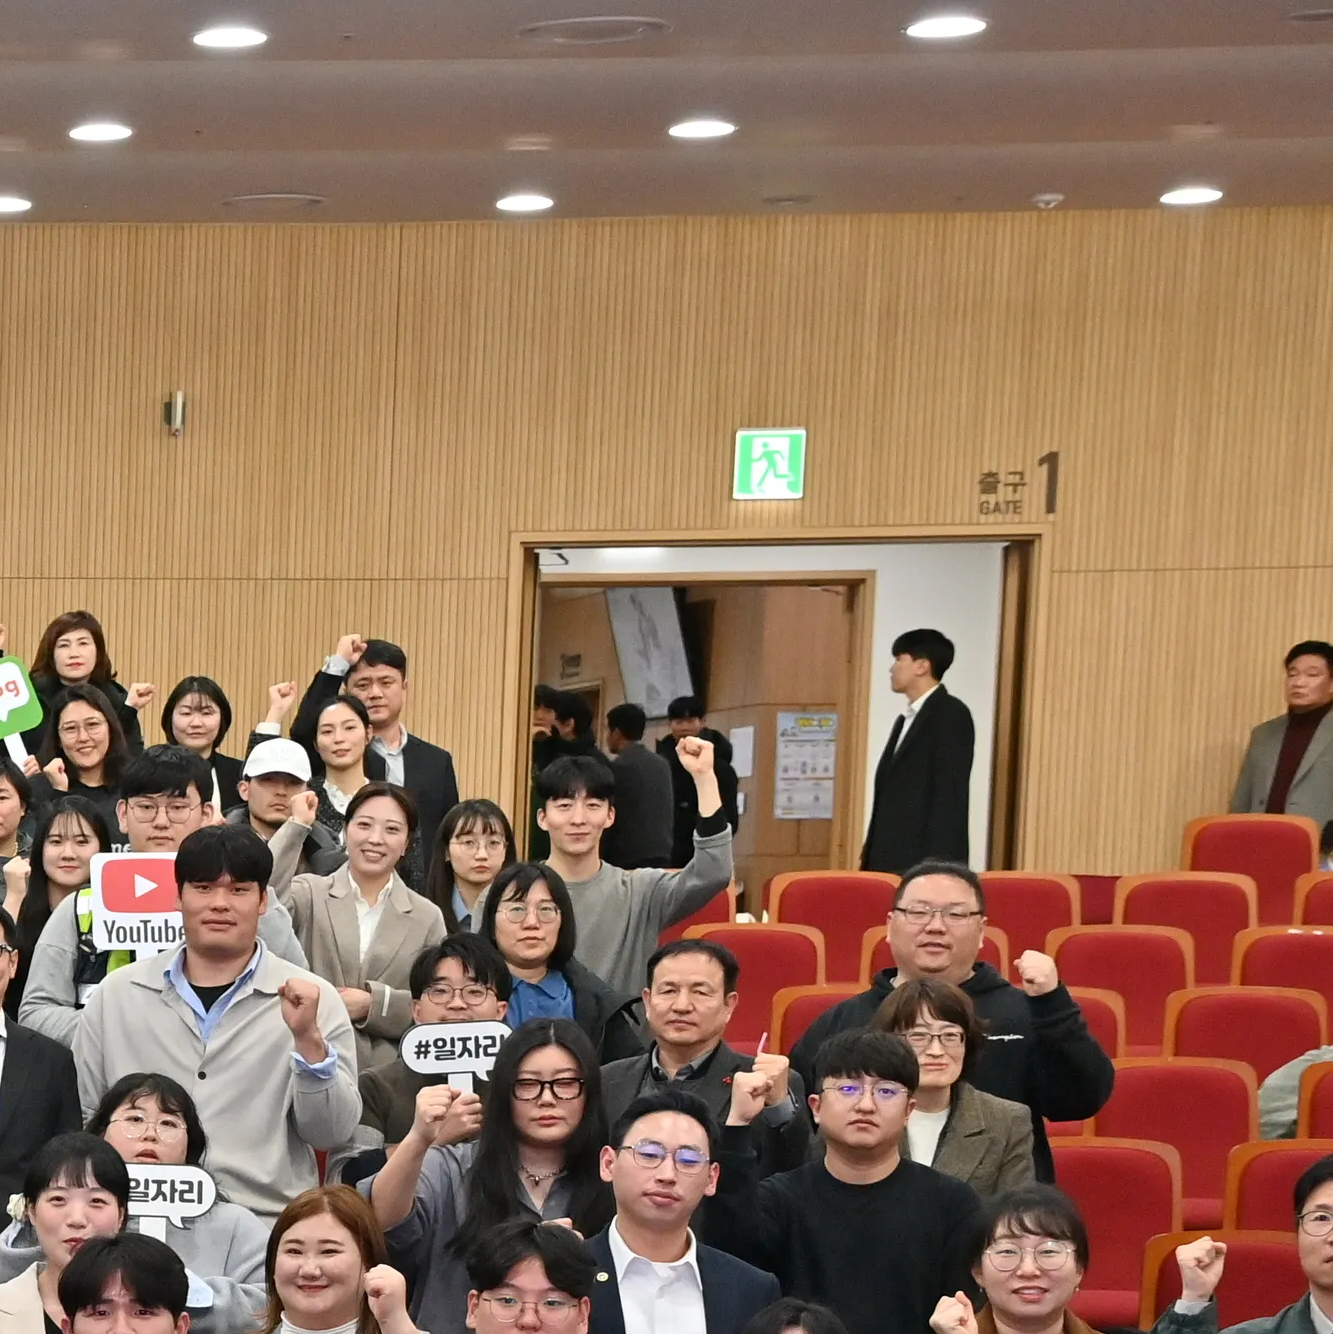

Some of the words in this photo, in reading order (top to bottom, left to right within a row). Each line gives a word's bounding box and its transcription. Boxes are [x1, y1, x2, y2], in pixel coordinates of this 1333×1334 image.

[978, 470, 1026, 494] 출구
[1038, 451, 1059, 514] 1
[979, 500, 1022, 515] GATE
